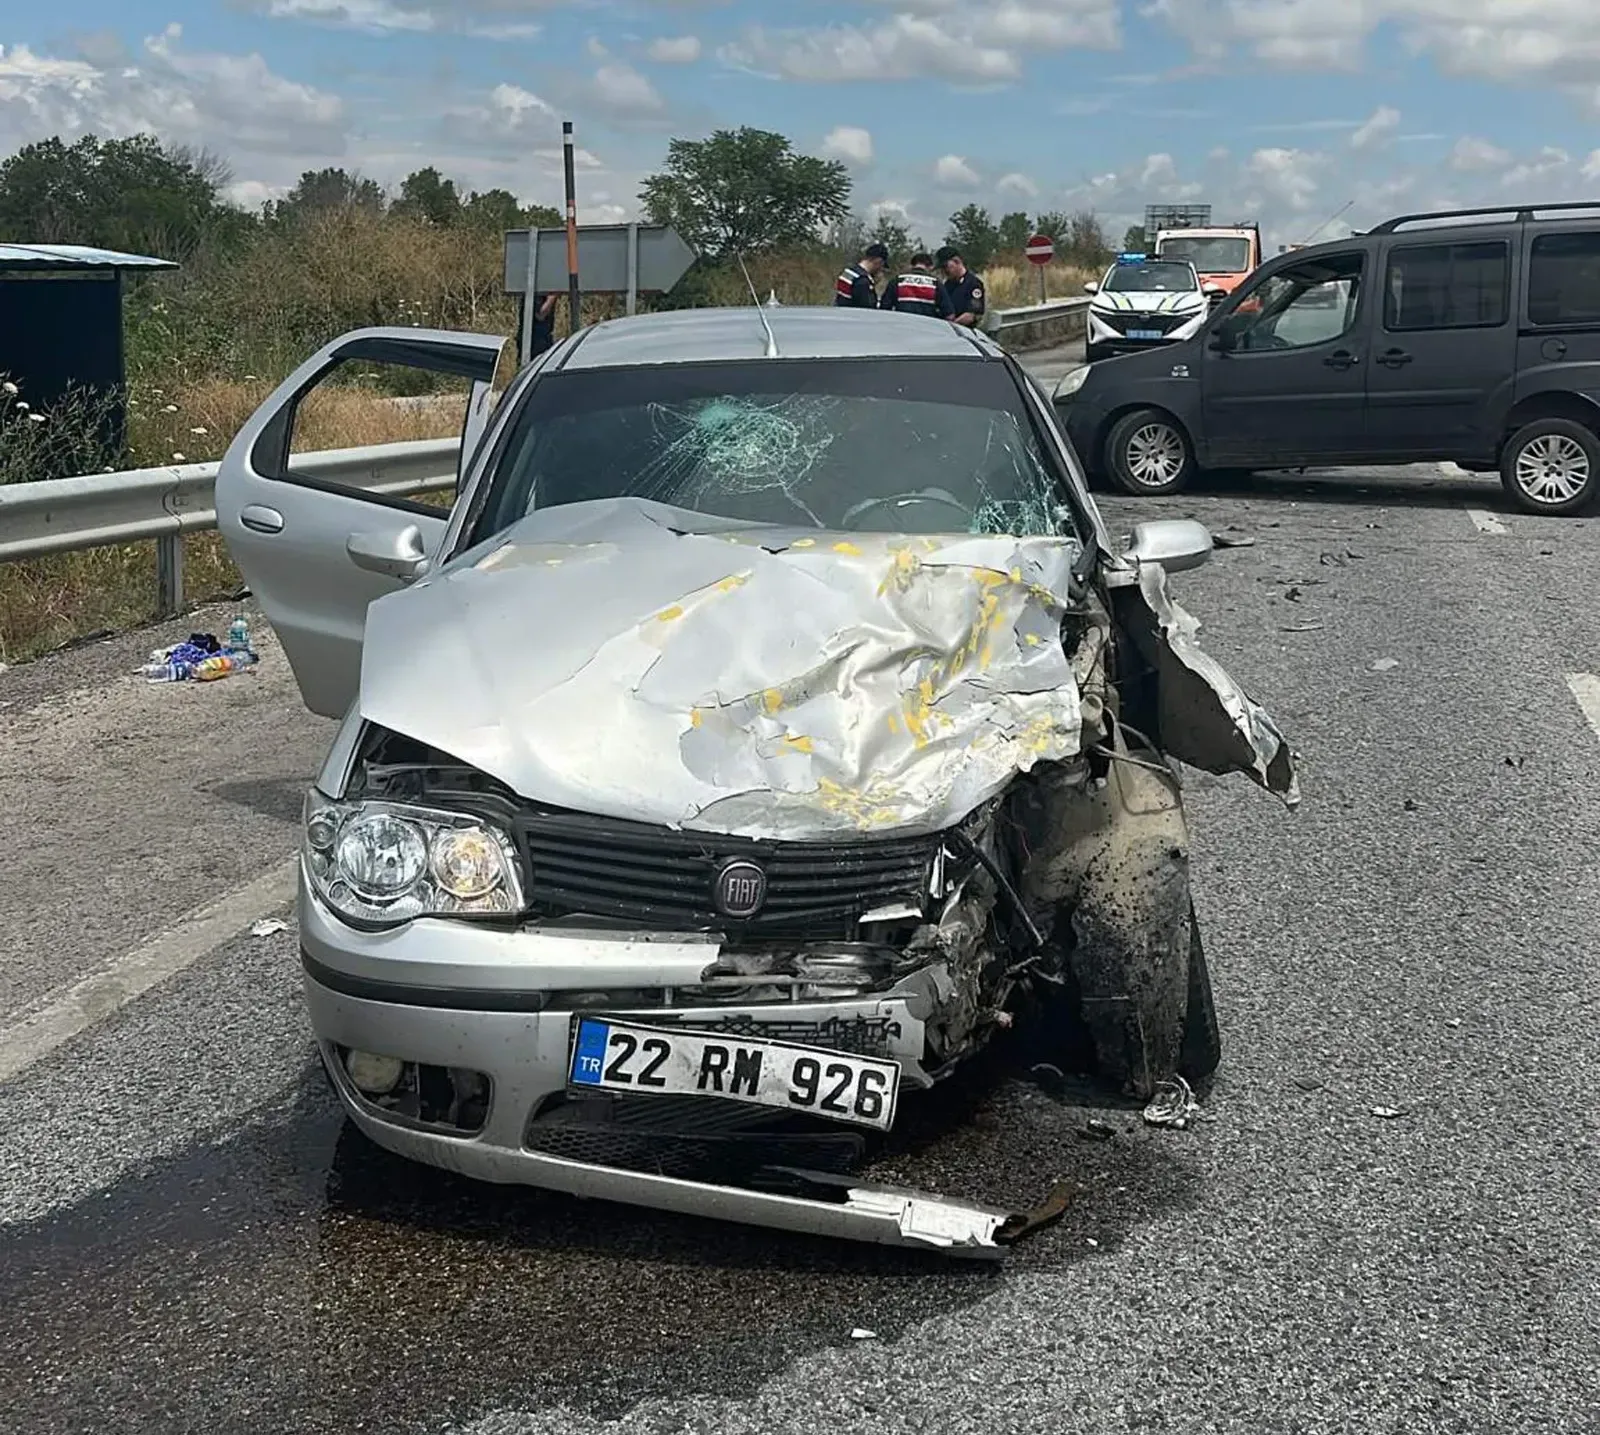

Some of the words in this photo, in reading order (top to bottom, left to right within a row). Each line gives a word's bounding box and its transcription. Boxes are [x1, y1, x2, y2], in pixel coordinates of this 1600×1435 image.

[727, 878, 758, 903] FIAT
[581, 1055, 600, 1073] TR
[603, 1032, 671, 1087] 22
[697, 1044, 763, 1096] RM
[788, 1057, 887, 1119] 926
